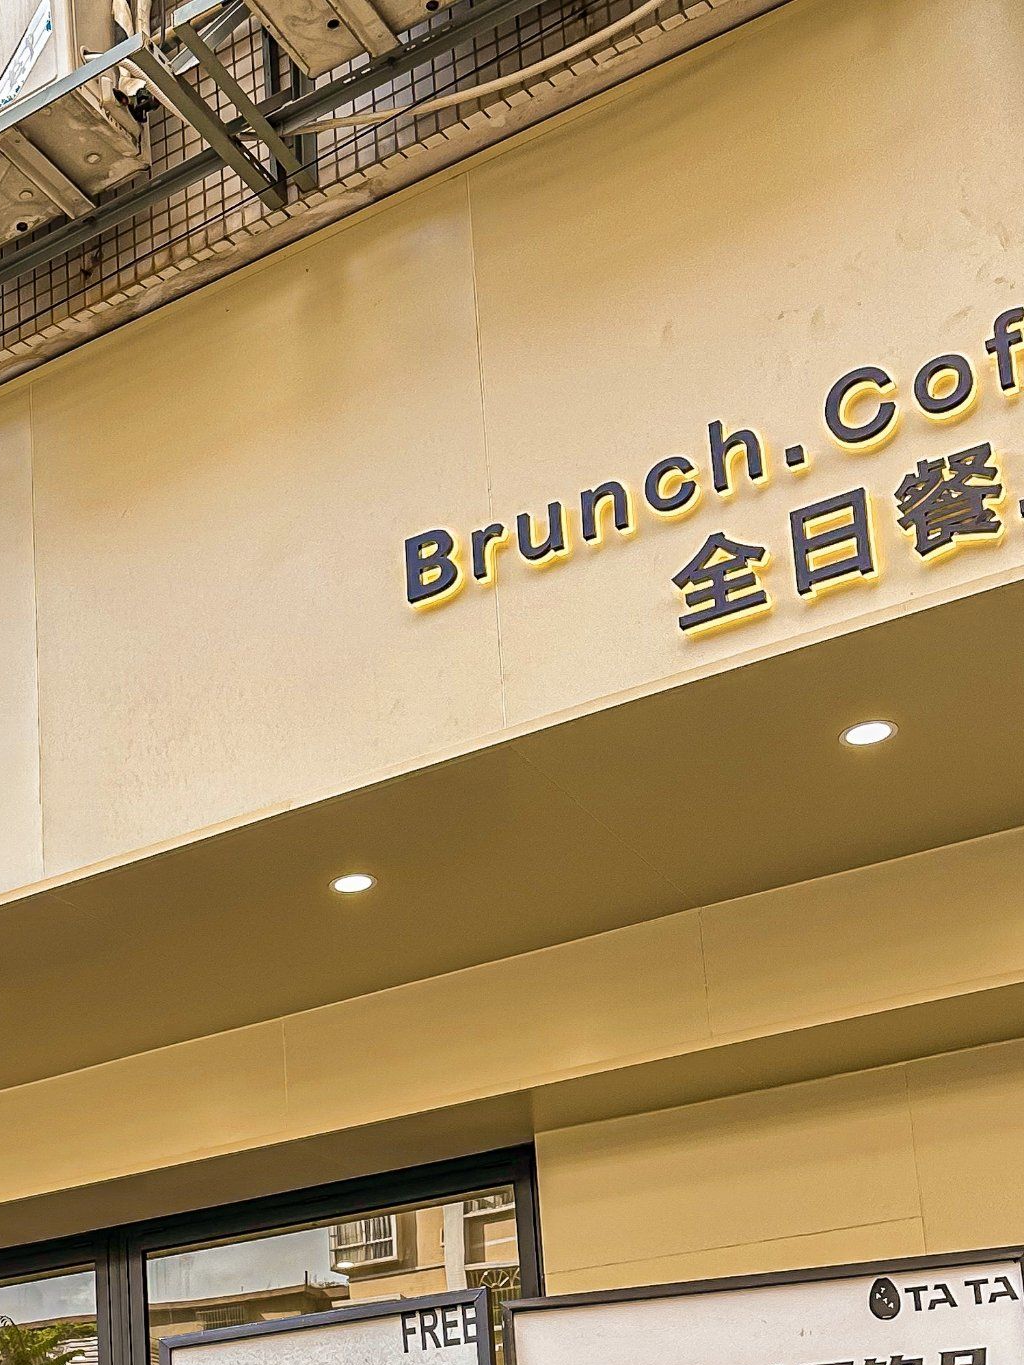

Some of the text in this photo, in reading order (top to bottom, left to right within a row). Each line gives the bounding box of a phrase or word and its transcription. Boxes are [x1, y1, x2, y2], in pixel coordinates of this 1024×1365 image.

[671, 441, 1004, 631] 全日餐
[401, 1305, 477, 1353] FREE
